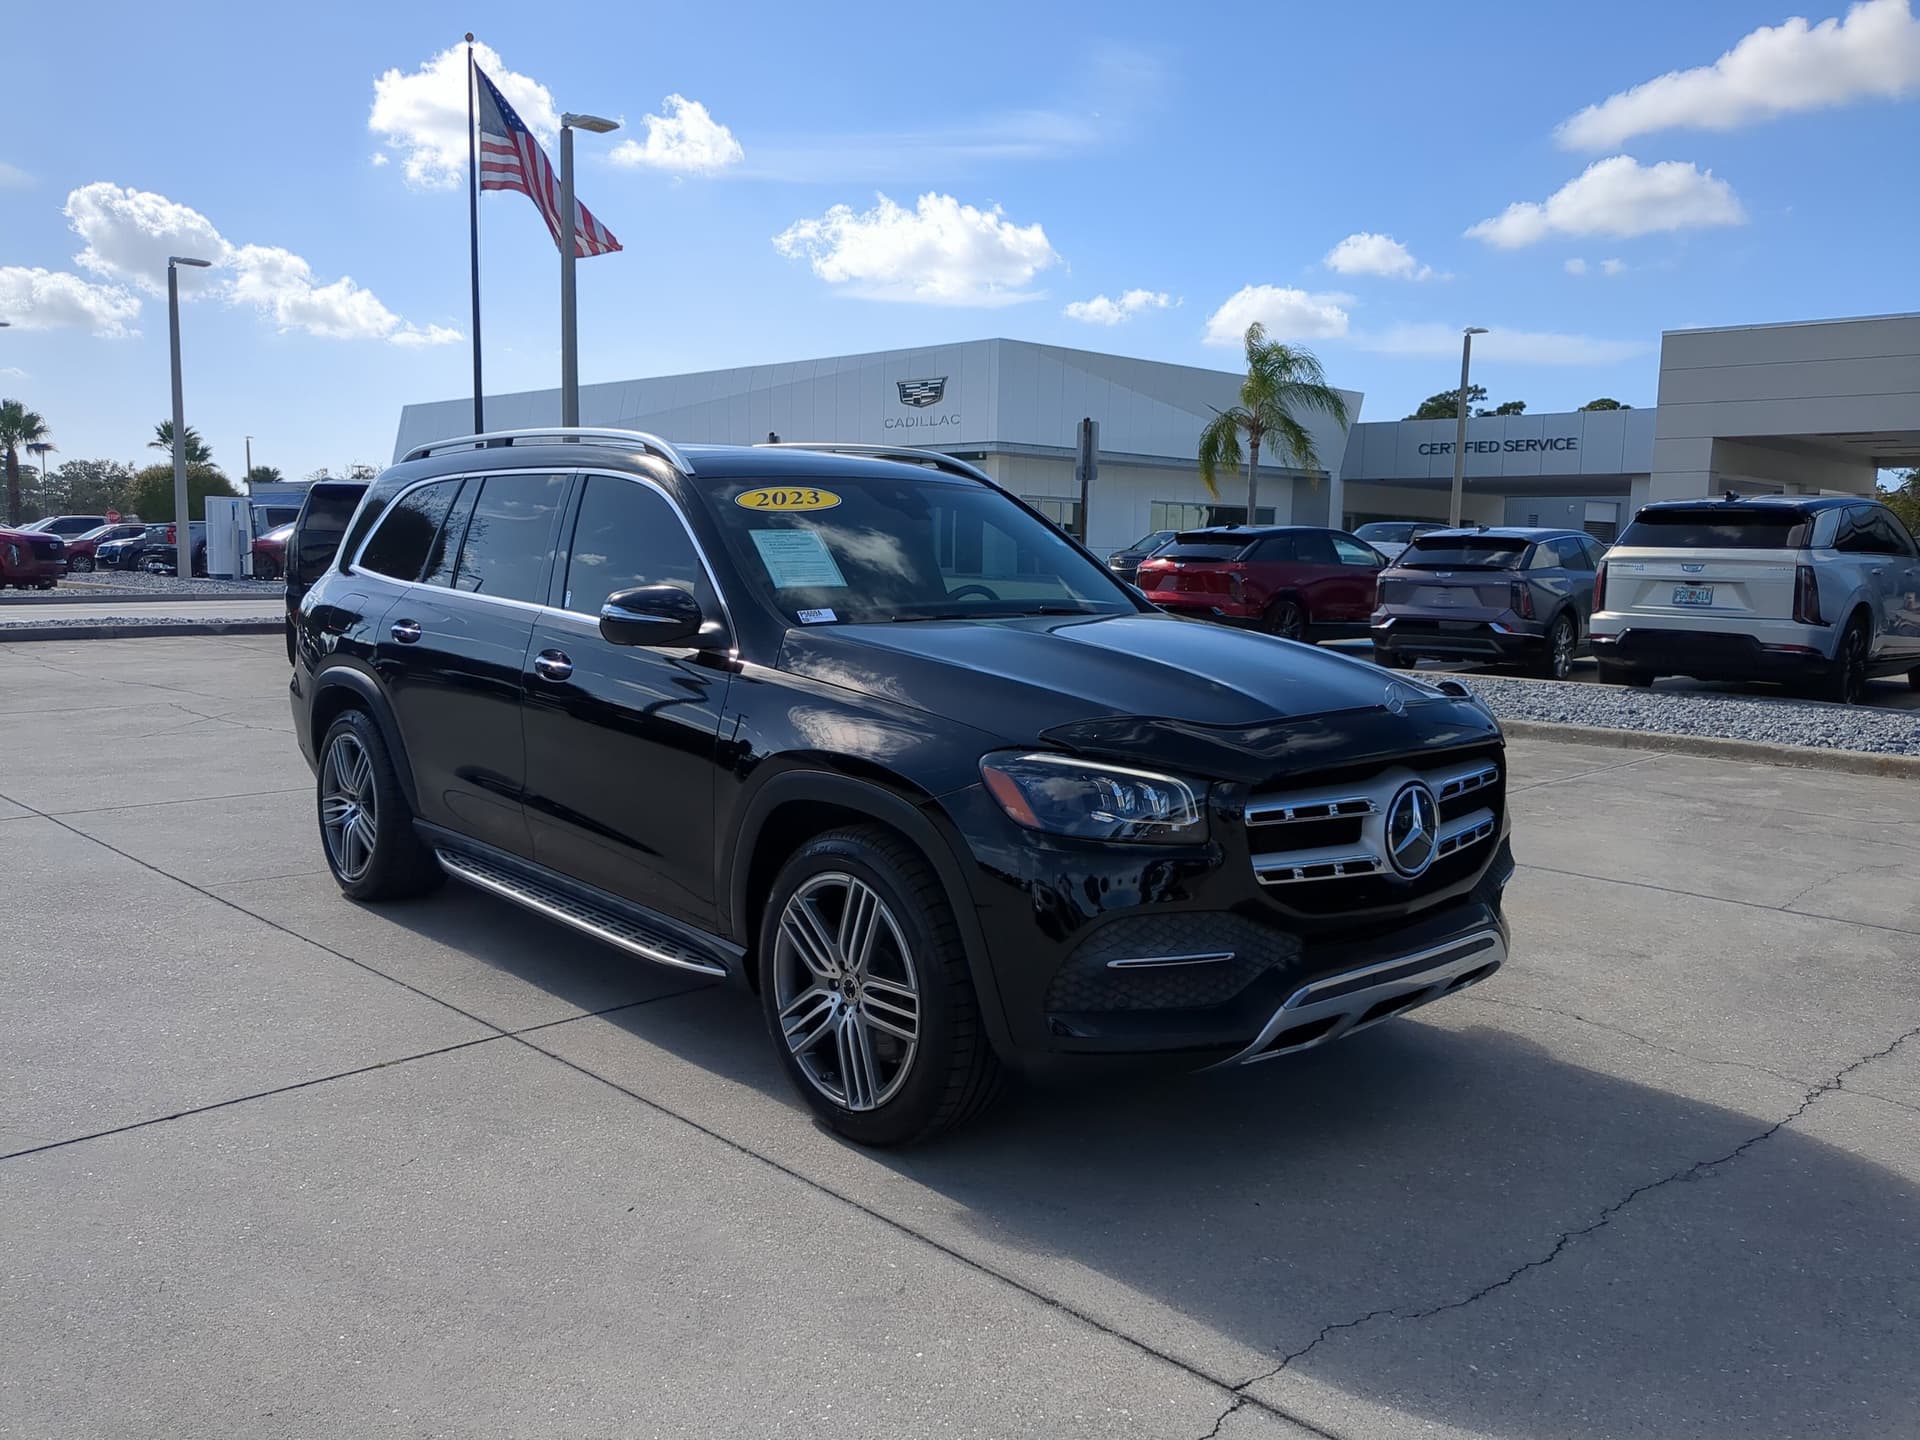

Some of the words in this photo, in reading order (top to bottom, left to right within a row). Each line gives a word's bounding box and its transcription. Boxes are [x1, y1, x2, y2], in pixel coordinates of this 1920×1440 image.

[884, 414, 961, 429] CADILLAC
[1418, 440, 1501, 456] CERTFIED
[1503, 437, 1578, 453] SERVICE
[755, 490, 820, 507] 2023
